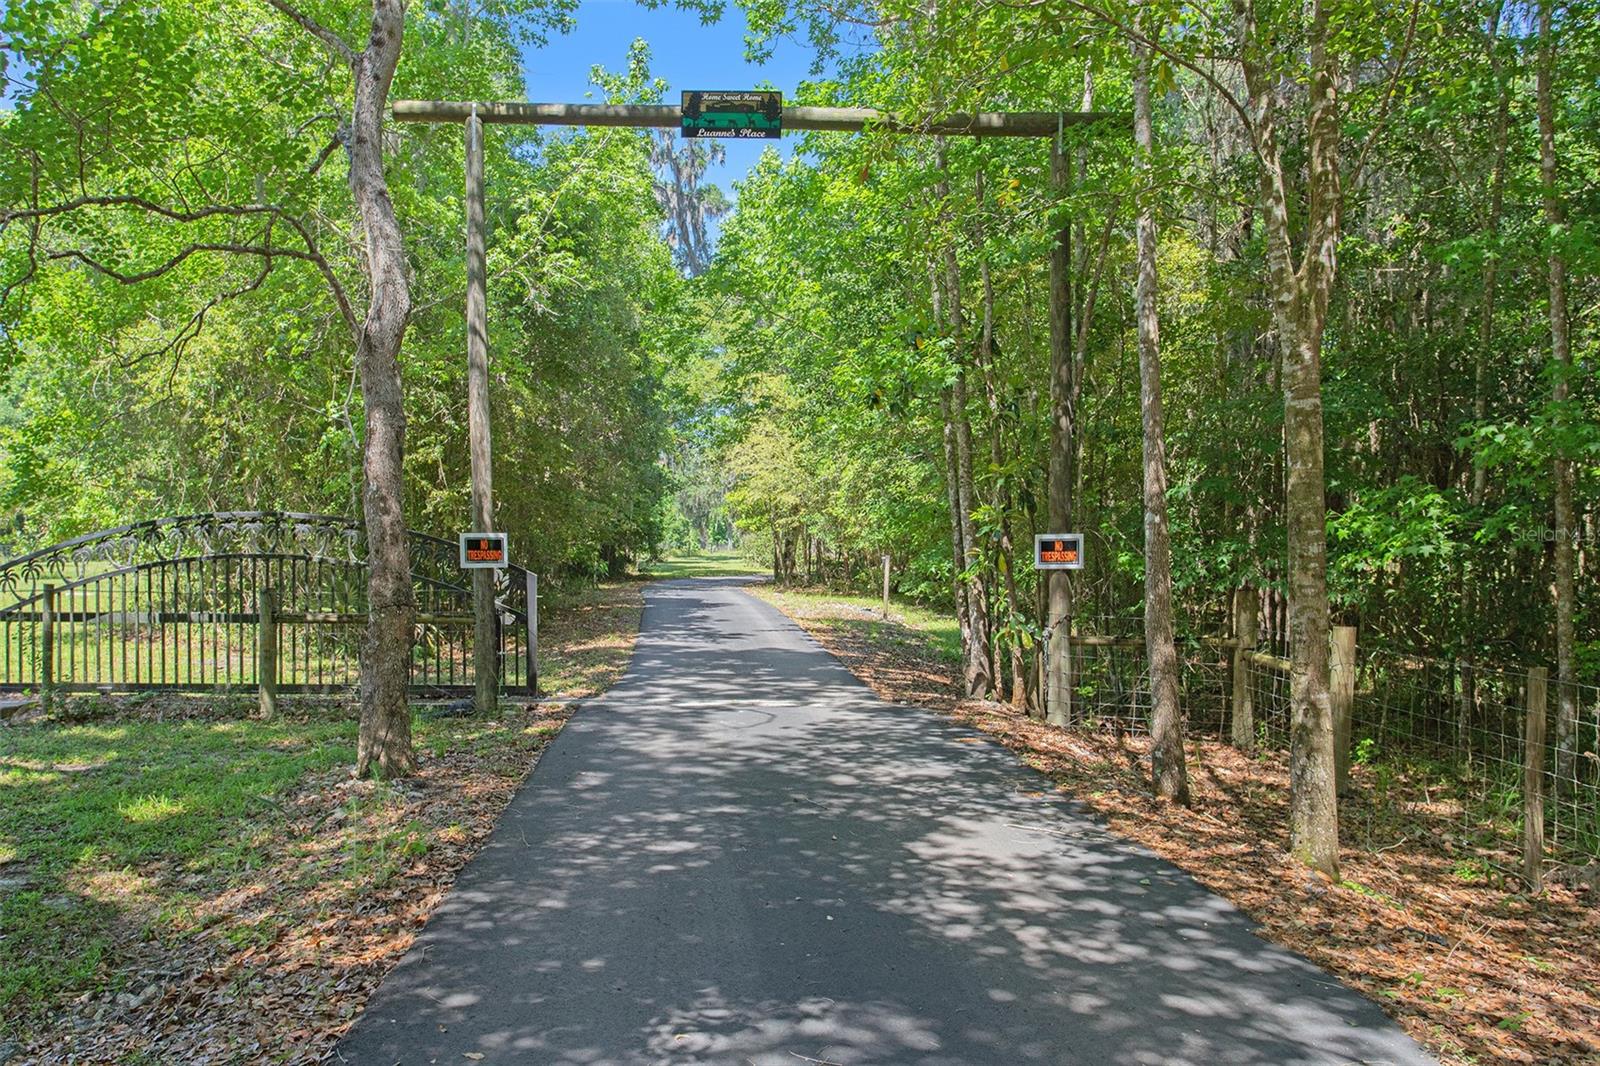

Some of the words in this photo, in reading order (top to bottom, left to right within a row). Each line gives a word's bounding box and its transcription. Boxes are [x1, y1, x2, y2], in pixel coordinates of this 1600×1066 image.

[702, 92, 721, 100] Home
[722, 92, 741, 100] Sweet
[743, 92, 762, 100] Home
[697, 128, 736, 137] Luanne's
[739, 128, 766, 138] Place
[467, 550, 502, 560] TRESPASSING
[1042, 551, 1077, 562] TRESPASSING
